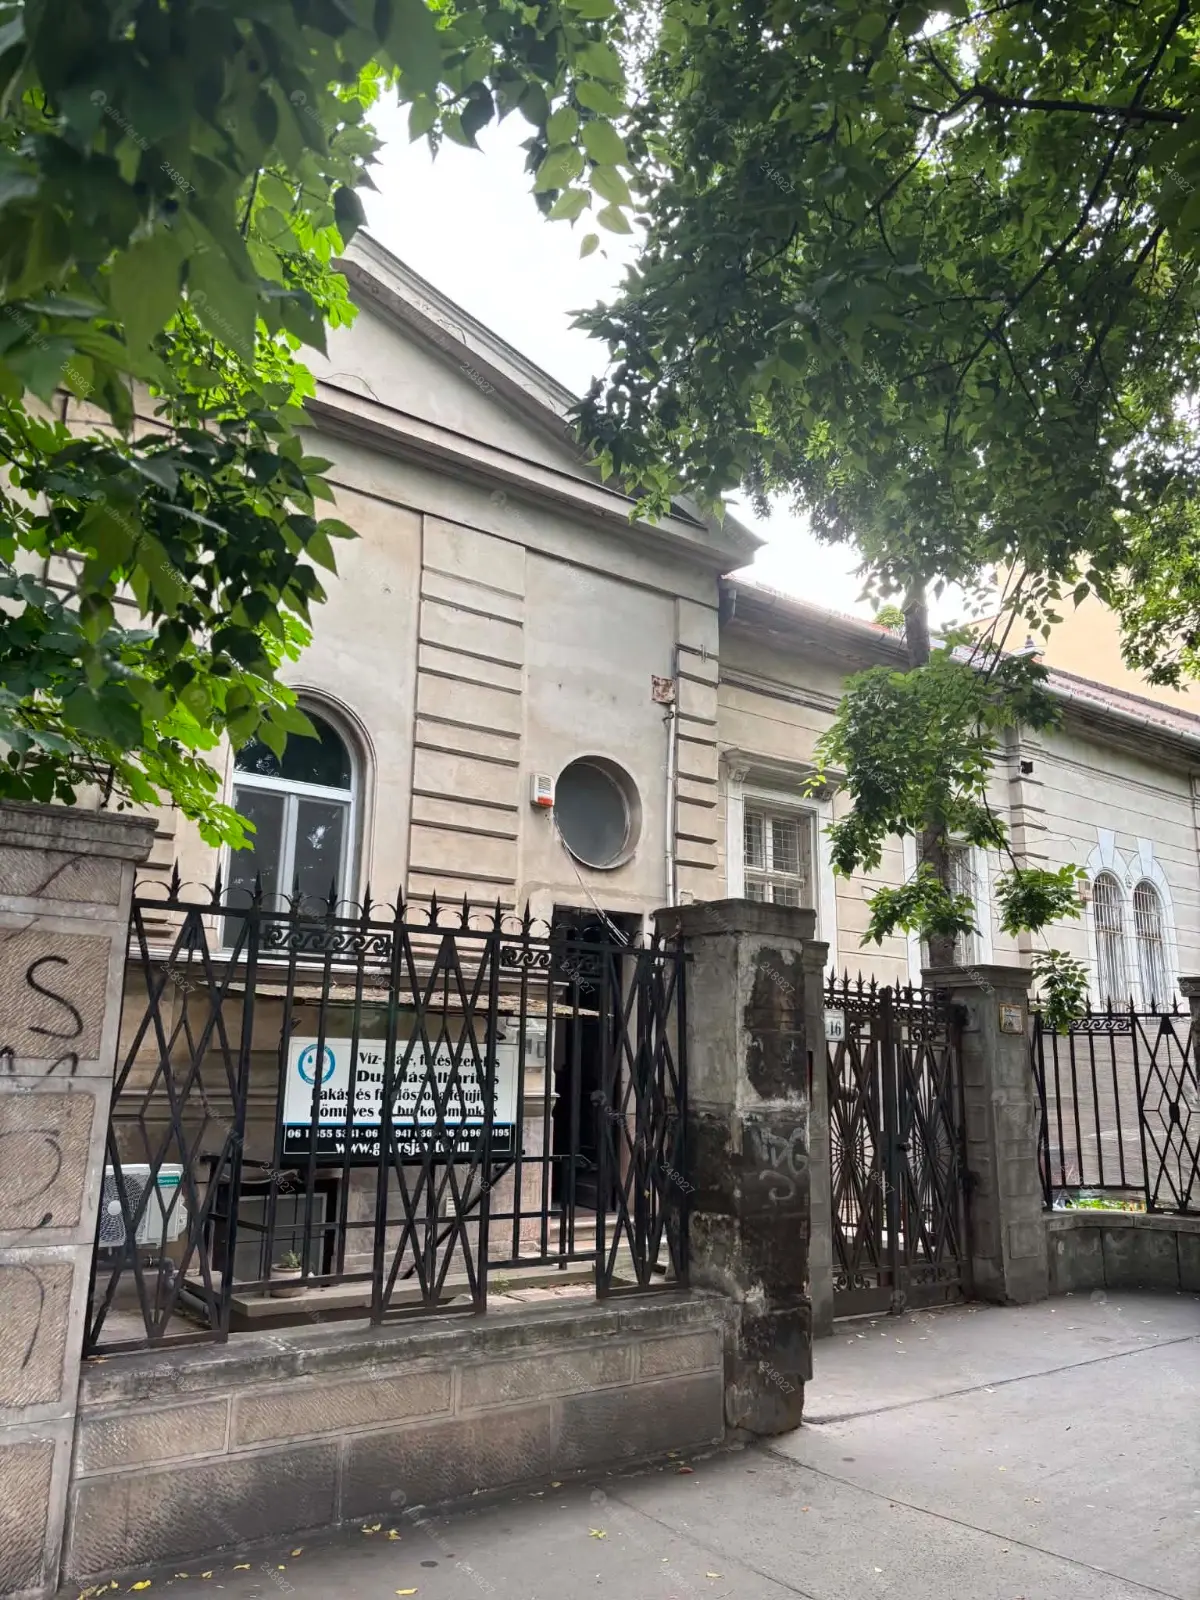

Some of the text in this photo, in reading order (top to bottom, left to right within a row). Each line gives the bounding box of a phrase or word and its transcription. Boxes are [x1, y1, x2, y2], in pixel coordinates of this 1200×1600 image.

[830, 1020, 842, 1036] 16
[356, 1088, 371, 1101] és
[287, 1128, 301, 1138] 06
[365, 1128, 378, 1138] 06
[395, 1128, 411, 1138] 941
